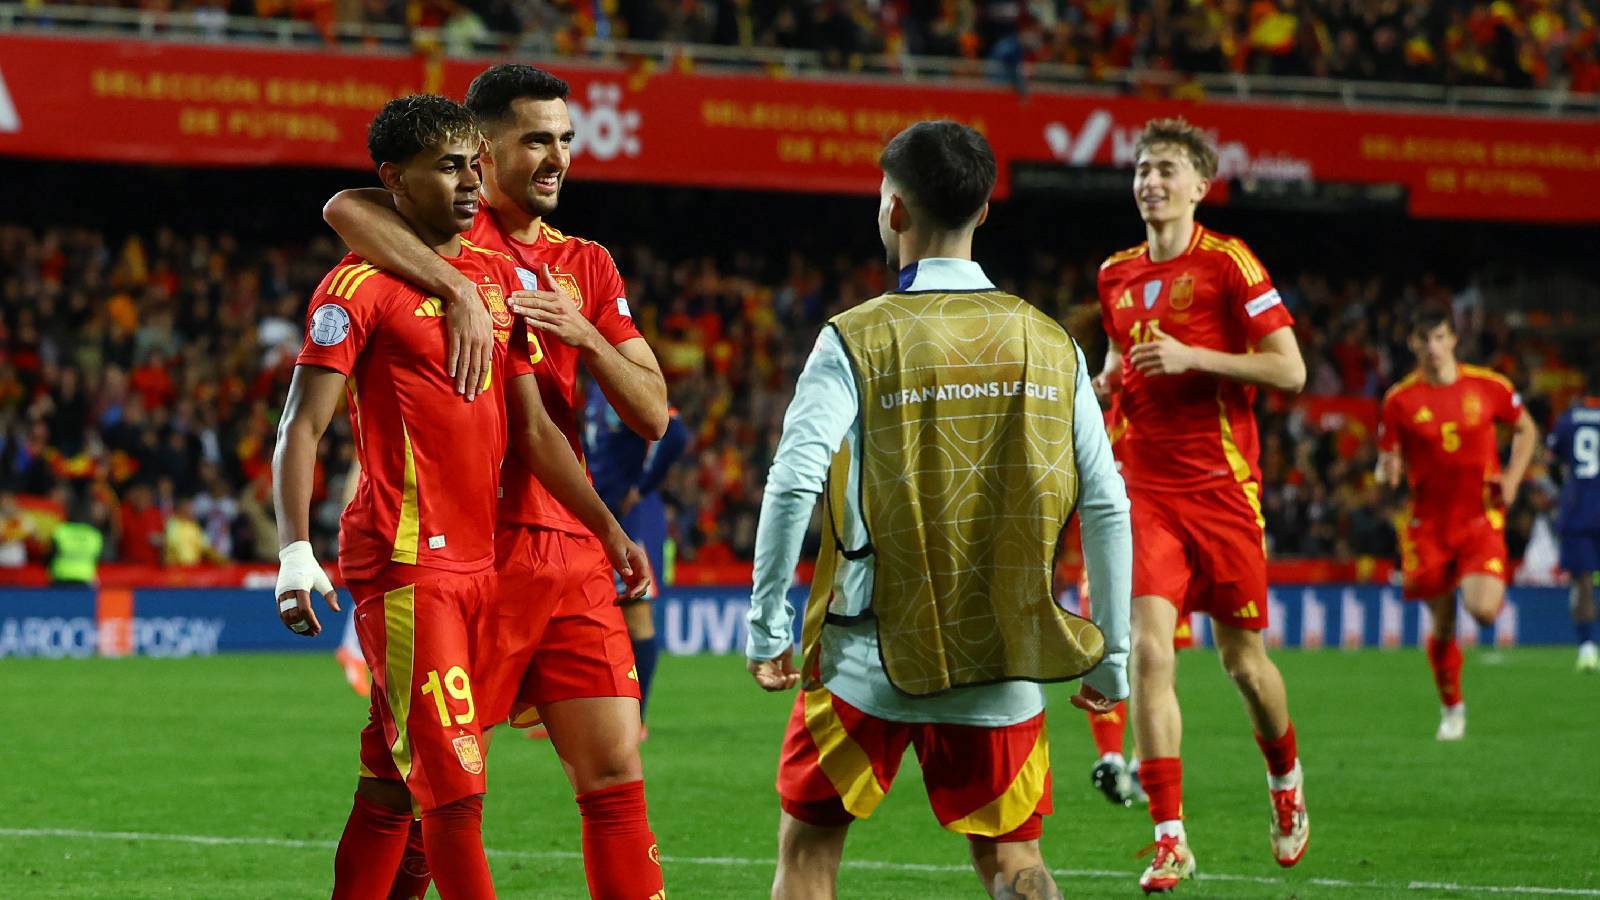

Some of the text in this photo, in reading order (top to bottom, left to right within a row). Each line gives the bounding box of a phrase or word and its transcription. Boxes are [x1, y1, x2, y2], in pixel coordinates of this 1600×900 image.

[880, 380, 1059, 409] UEFA NATIONS LEGUE
[1573, 425, 1600, 479] 9
[421, 665, 475, 727] 19
